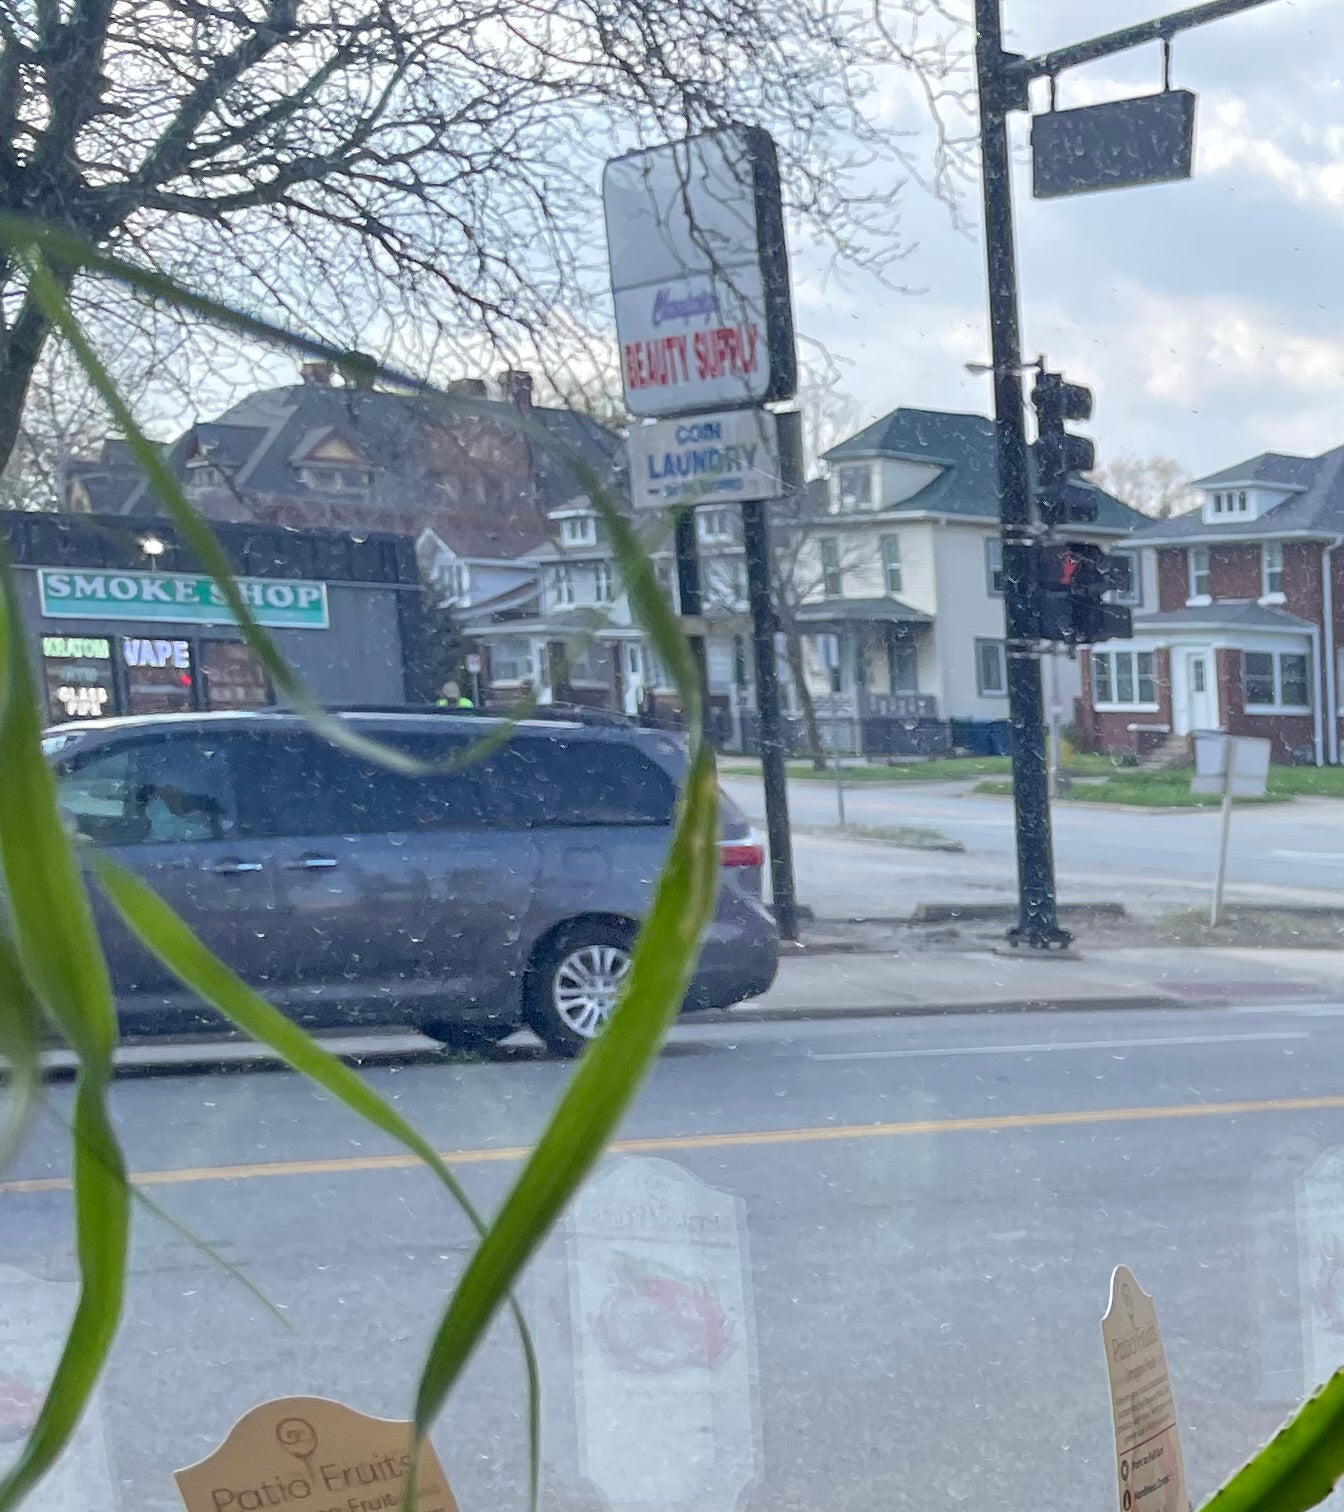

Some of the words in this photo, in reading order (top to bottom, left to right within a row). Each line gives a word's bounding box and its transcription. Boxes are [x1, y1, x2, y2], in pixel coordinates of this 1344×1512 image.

[625, 335, 690, 390] BEAUTY
[694, 323, 758, 381] SUPPLY
[675, 421, 721, 446] COIN
[648, 444, 758, 480] LAUNDRY
[47, 574, 200, 603] SMOKE
[209, 582, 319, 609] SHOP
[123, 638, 190, 668] VAPE
[320, 1453, 414, 1492] Fruits
